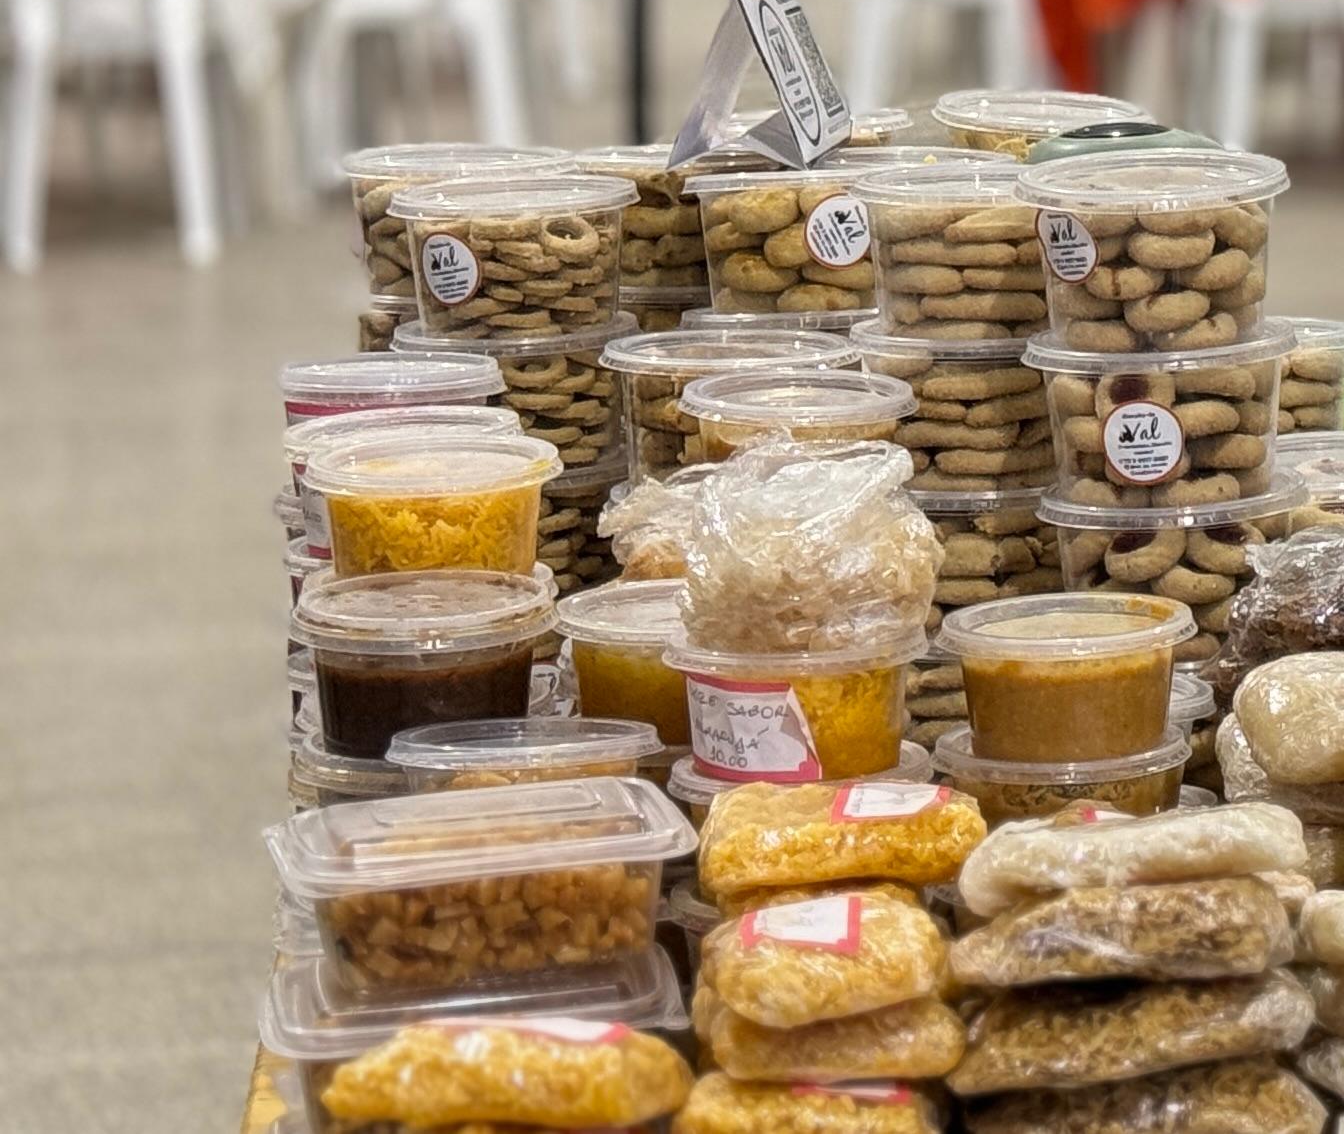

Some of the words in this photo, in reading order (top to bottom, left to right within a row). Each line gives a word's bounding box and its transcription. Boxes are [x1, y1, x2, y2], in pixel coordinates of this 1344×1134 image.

[835, 209, 865, 245] Val
[1050, 219, 1078, 244] Val
[431, 246, 460, 271] Val
[1120, 417, 1162, 443] Val
[727, 702, 790, 720] SABOR
